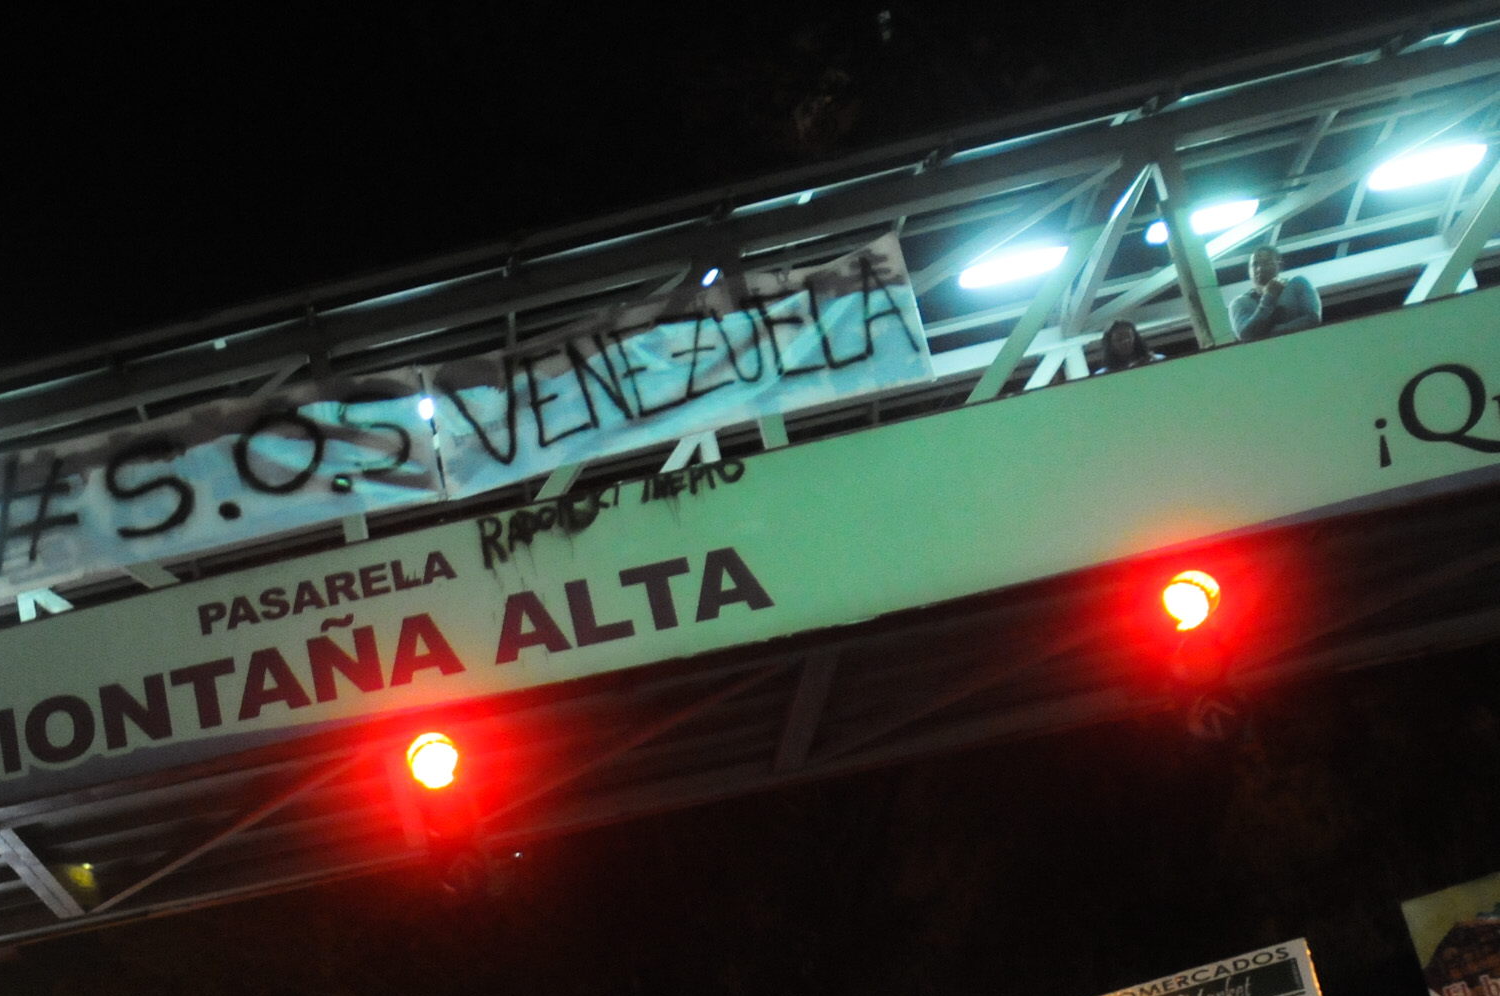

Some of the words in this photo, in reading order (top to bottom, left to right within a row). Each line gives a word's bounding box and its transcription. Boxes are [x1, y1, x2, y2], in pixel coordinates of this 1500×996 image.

[435, 254, 922, 466] VENEZUELA
[1373, 363, 1500, 470] ¡Q
[197, 550, 458, 636] PASARELA
[495, 546, 776, 667] ALTA
